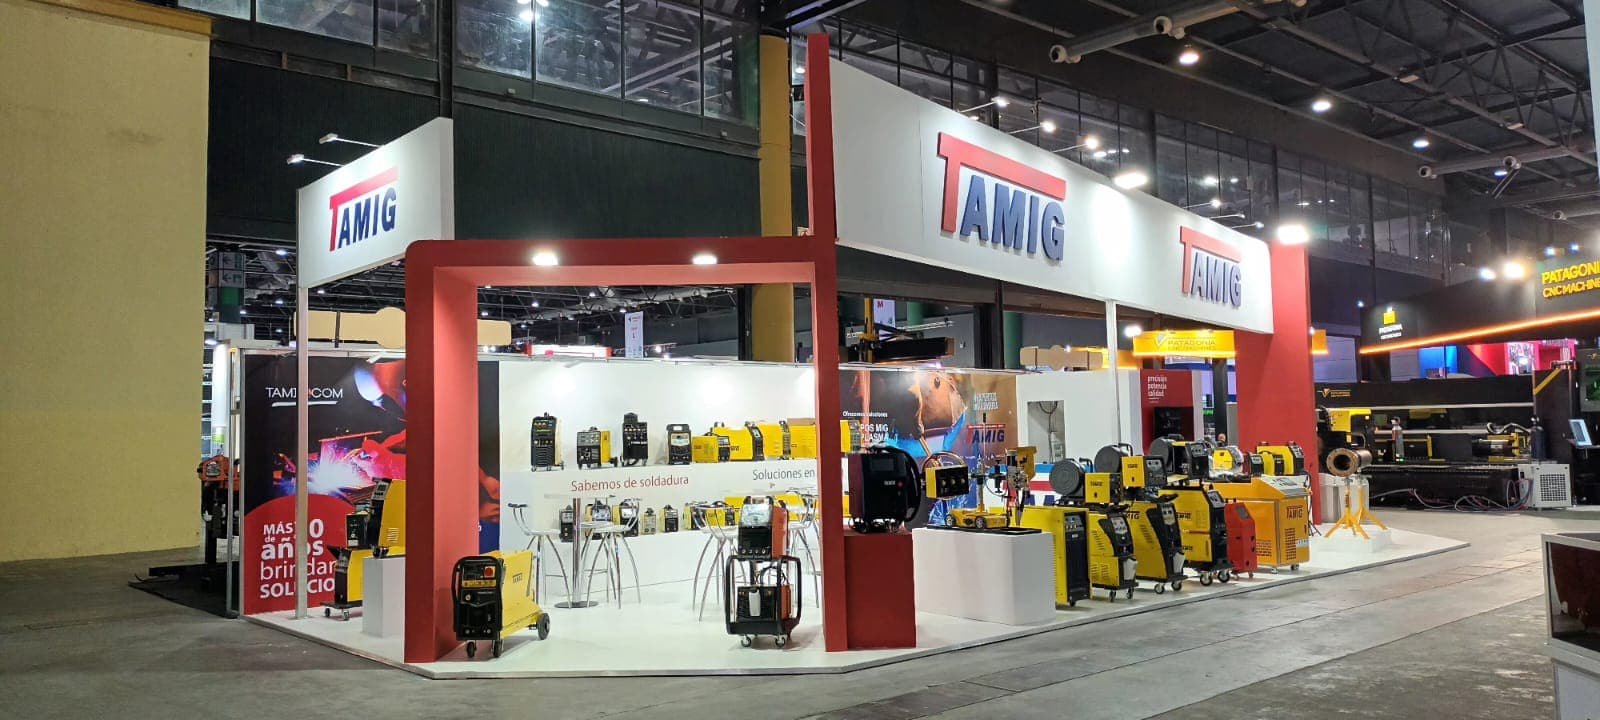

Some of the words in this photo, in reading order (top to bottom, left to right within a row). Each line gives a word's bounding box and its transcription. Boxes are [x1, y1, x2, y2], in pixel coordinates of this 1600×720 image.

[937, 132, 1066, 262] TAMIG
[329, 166, 399, 252] TAMIG
[1180, 225, 1242, 307] TAMIG
[967, 424, 1006, 445] TAMIG
[571, 480, 621, 492] Sabemos
[624, 478, 637, 489] de
[640, 475, 689, 487] soldadura
[752, 468, 802, 480] Soluciones
[804, 469, 816, 479] en
[263, 521, 294, 536] MÁS
[264, 534, 276, 543] de
[259, 578, 335, 599] SOLCIO
